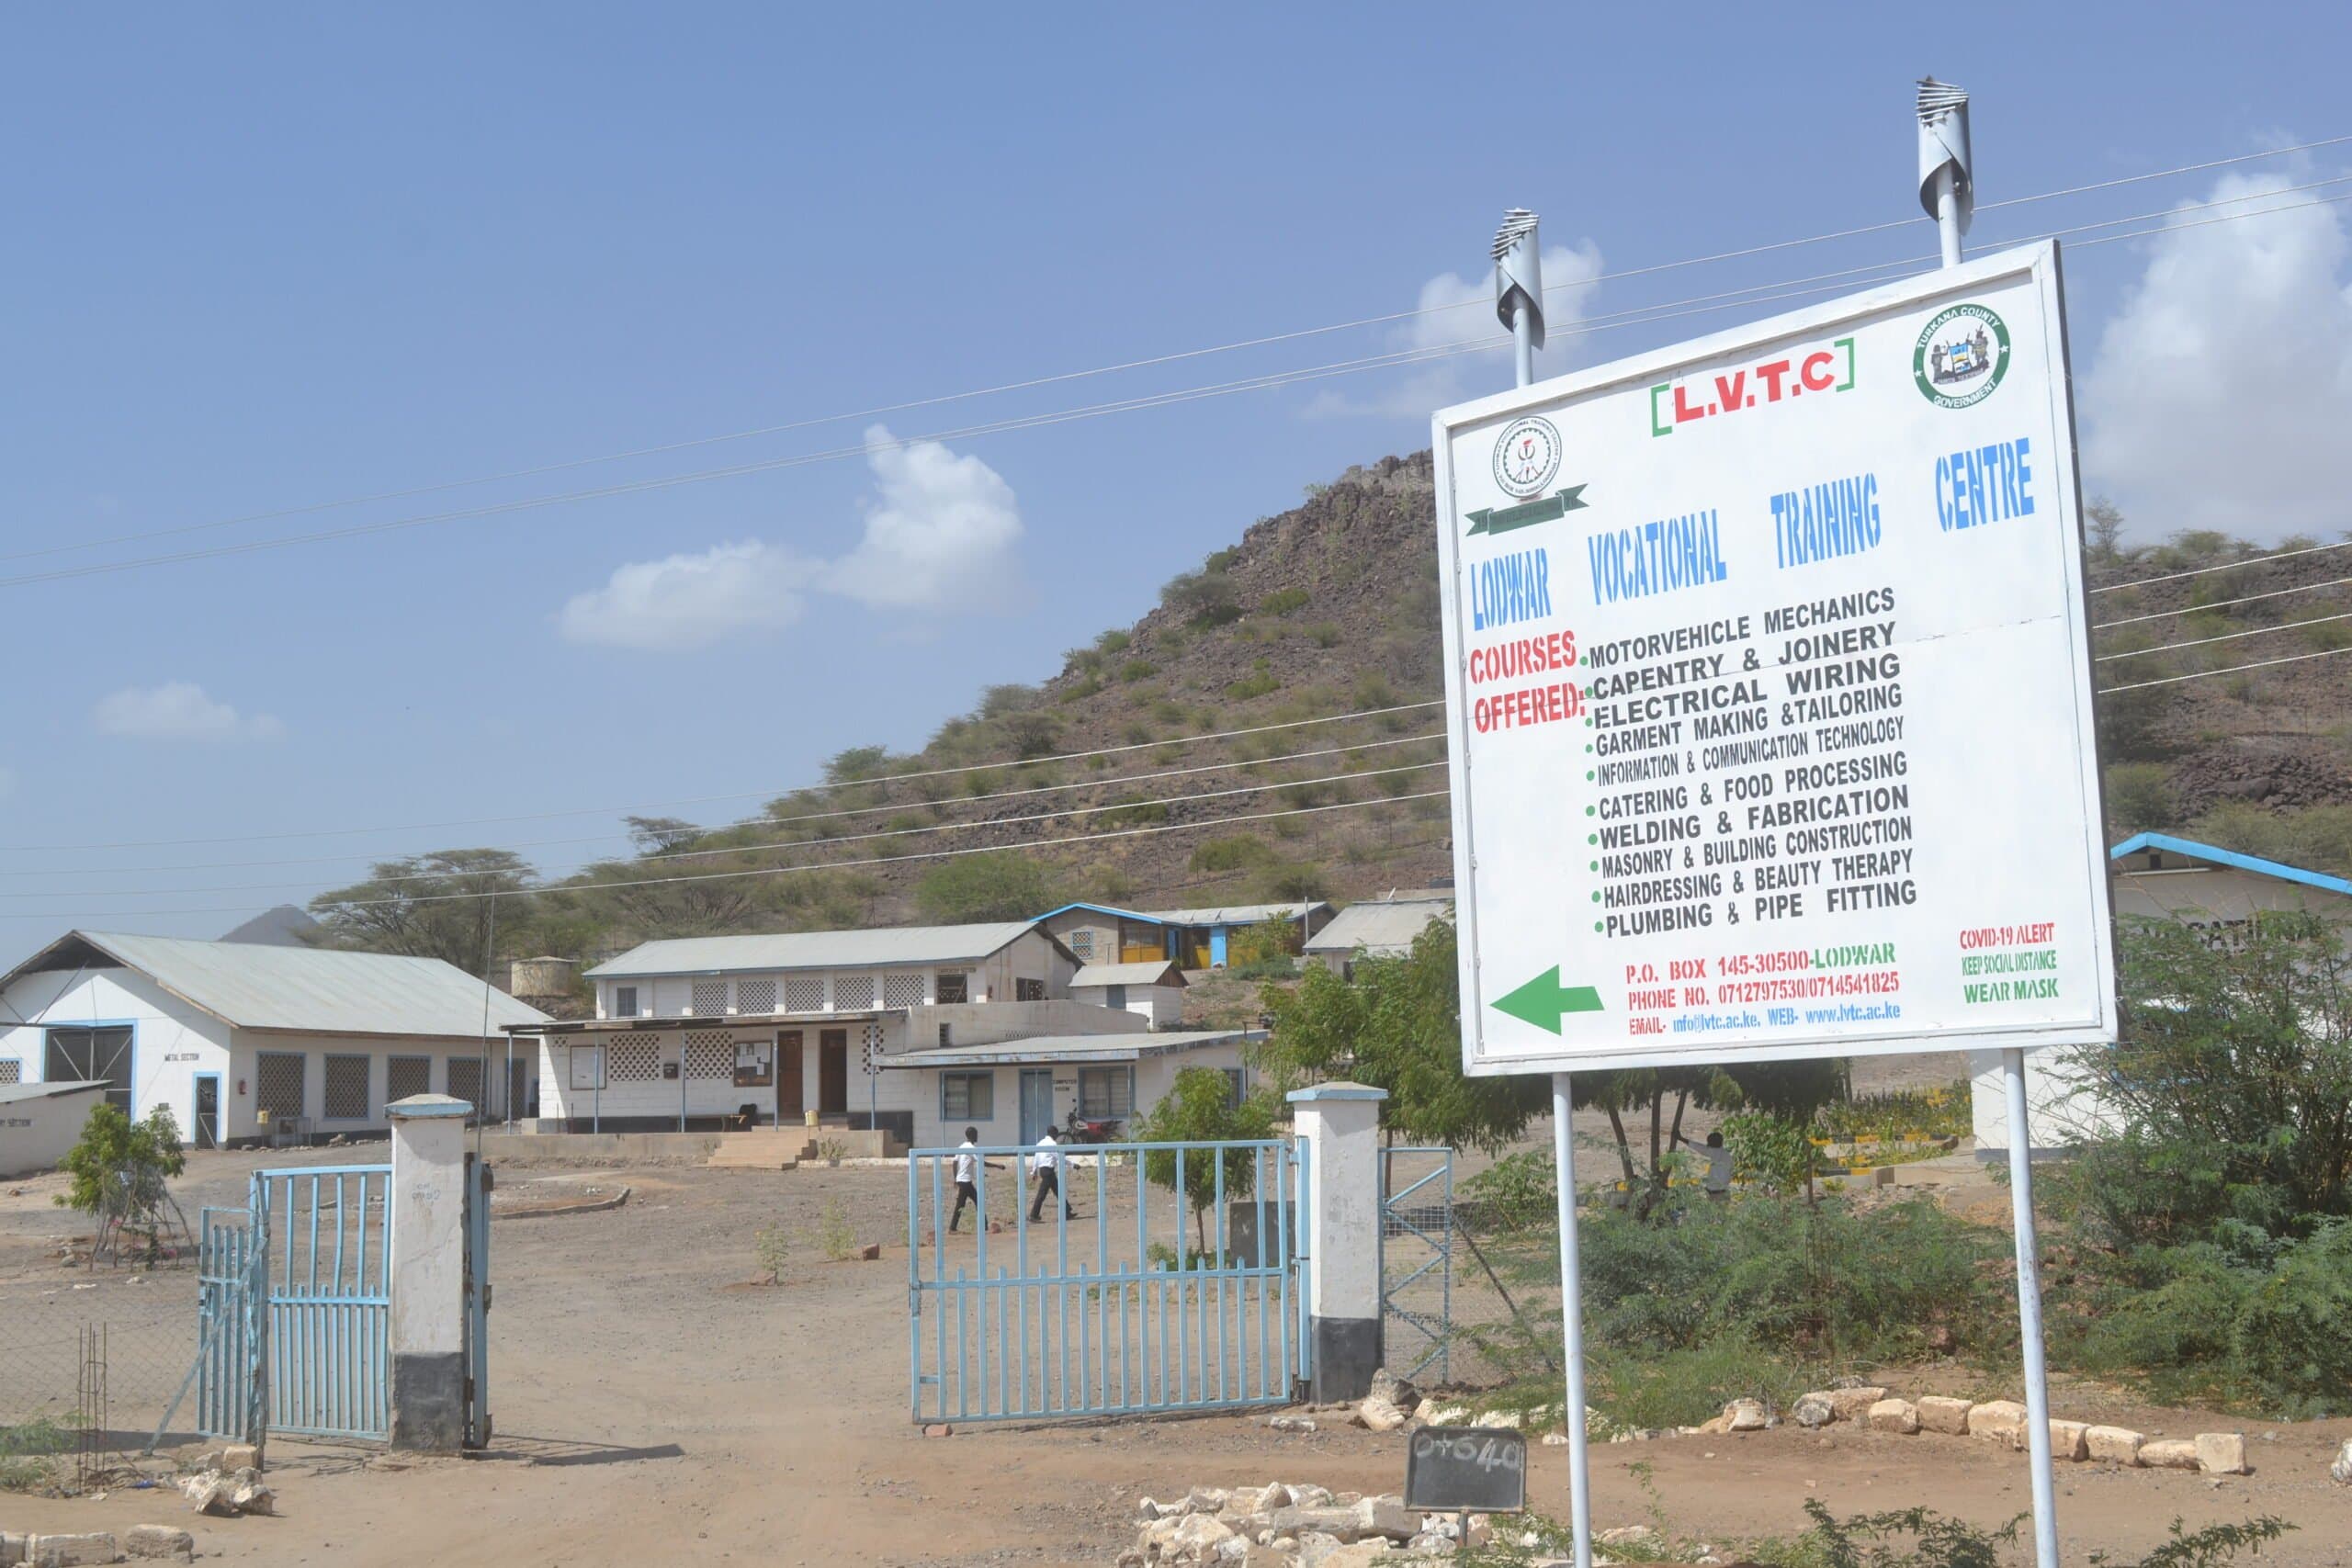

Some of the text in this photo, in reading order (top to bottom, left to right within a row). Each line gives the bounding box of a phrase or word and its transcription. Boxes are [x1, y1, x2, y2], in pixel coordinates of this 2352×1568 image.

[1917, 307, 2001, 348] TURKANA COUNTY
[1933, 378, 1997, 408] GOVERNMENT
[1471, 437, 2035, 631] LODWAR VOCATIONAL TRAINING CENTRE
[1589, 587, 1894, 669] MOTORVEHICLE MECHANICS
[1470, 630, 1577, 684] COURSES
[1593, 621, 1895, 700] CAPENTRY & JOINERY
[1475, 682, 1586, 733] OFFERED:
[1594, 653, 1900, 729] ELECTRICAL WIRING
[1596, 721, 1681, 757] GARMENT
[1693, 706, 1768, 741] MAKING
[1598, 716, 1904, 786] INFORMATION & COMMUNICATION TECHNOLOGY
[1600, 750, 1907, 820] CATERING & FOOD PROCESSING
[1600, 784, 1908, 850] WELDING & FABRICATION
[1602, 816, 1912, 879] MASONRY & BUILDING CONSTRUCTION
[1604, 848, 1913, 908] HAIRDRESSING & BEAUTY THERAPY
[1606, 879, 1917, 938] PLUMBING & PIPE FITTING
[1960, 922, 2054, 950] COVID-19 ALERT
[1962, 950, 2057, 976] KEEP SOCIAL DISTANCE
[1626, 942, 1895, 985] P.O. BOX 145-30500-LODWAR
[1629, 971, 1899, 1010] PHONE NO. 0712797530/0714541825
[1963, 978, 2059, 1003] WEAR MASK
[1805, 1001, 1900, 1023] www.lvtc.ac.ke
